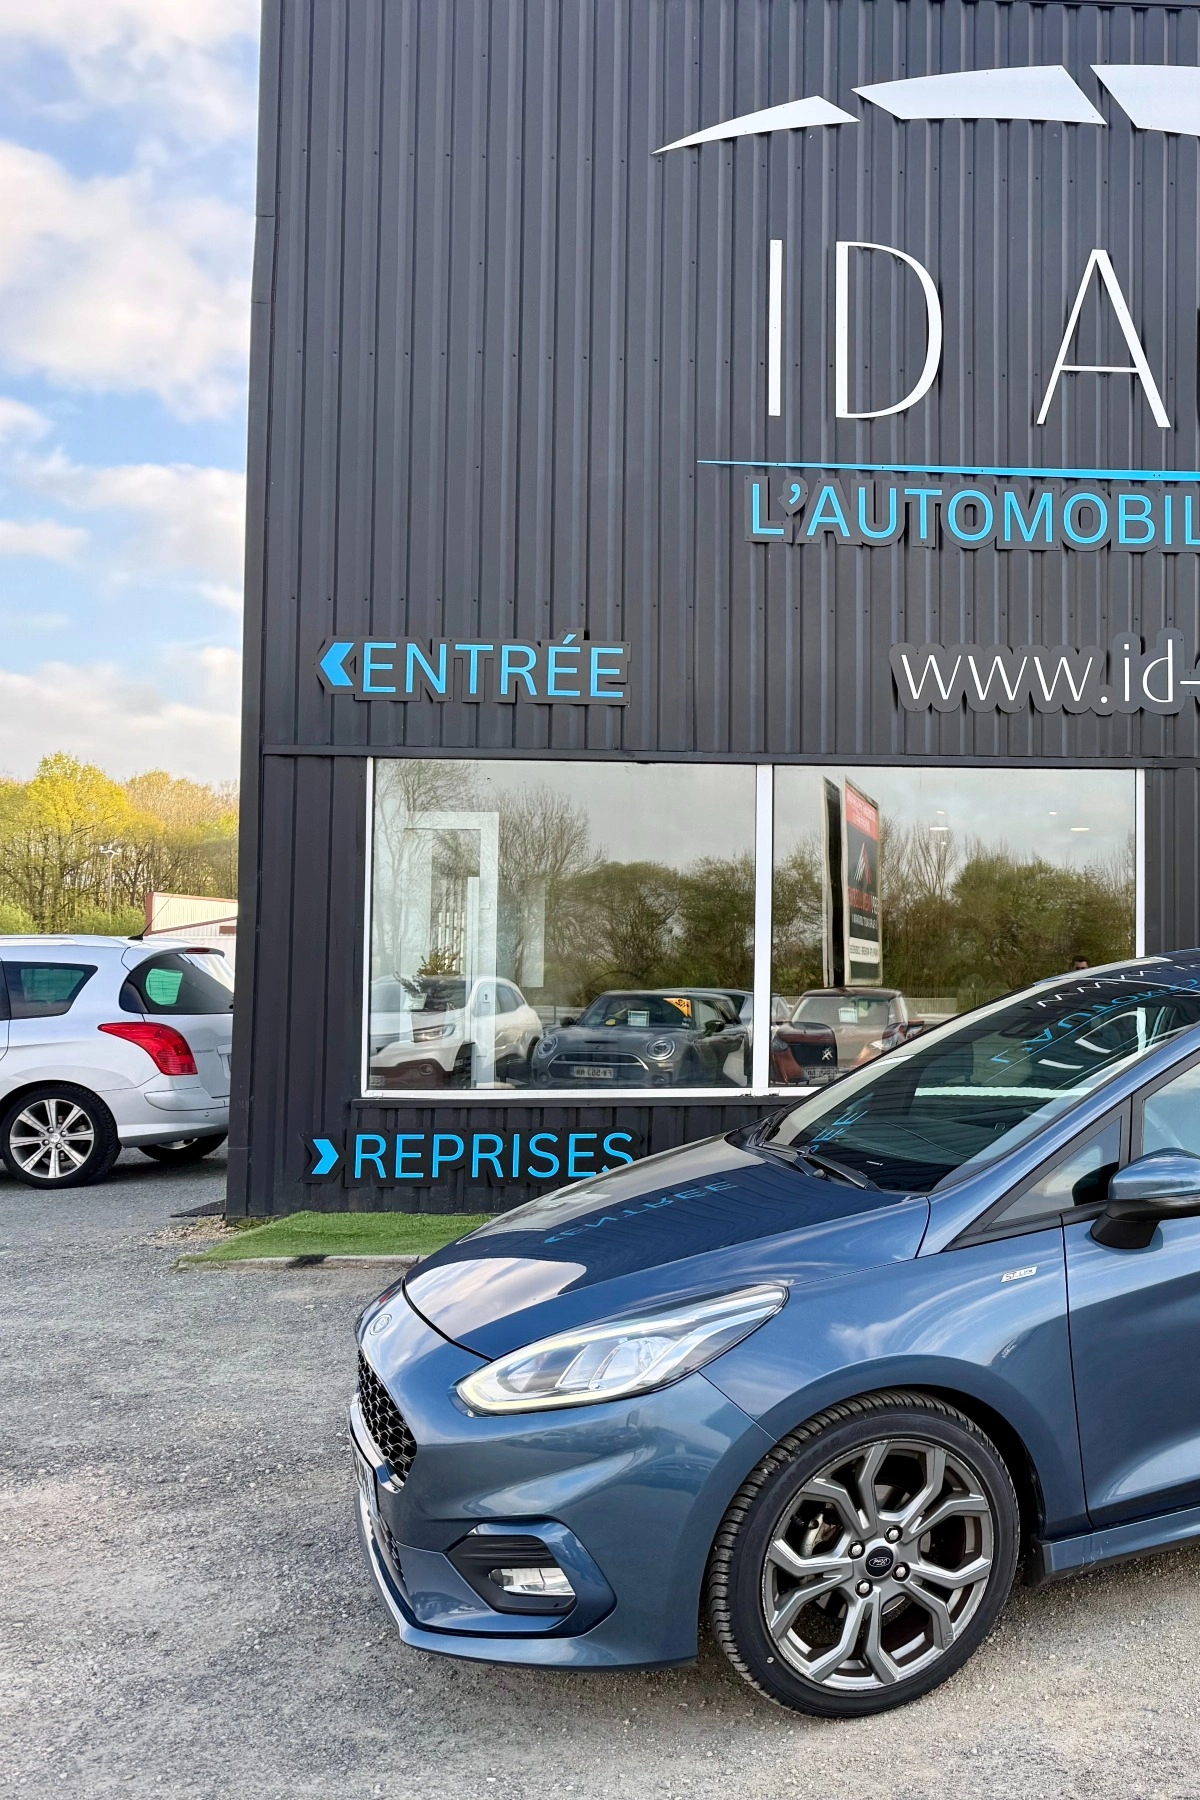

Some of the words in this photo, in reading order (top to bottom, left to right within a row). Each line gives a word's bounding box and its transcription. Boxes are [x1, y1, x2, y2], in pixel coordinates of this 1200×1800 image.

[768, 239, 942, 419] ID
[362, 634, 625, 698] ENTRÉE
[354, 1132, 634, 1179] REPRISES
